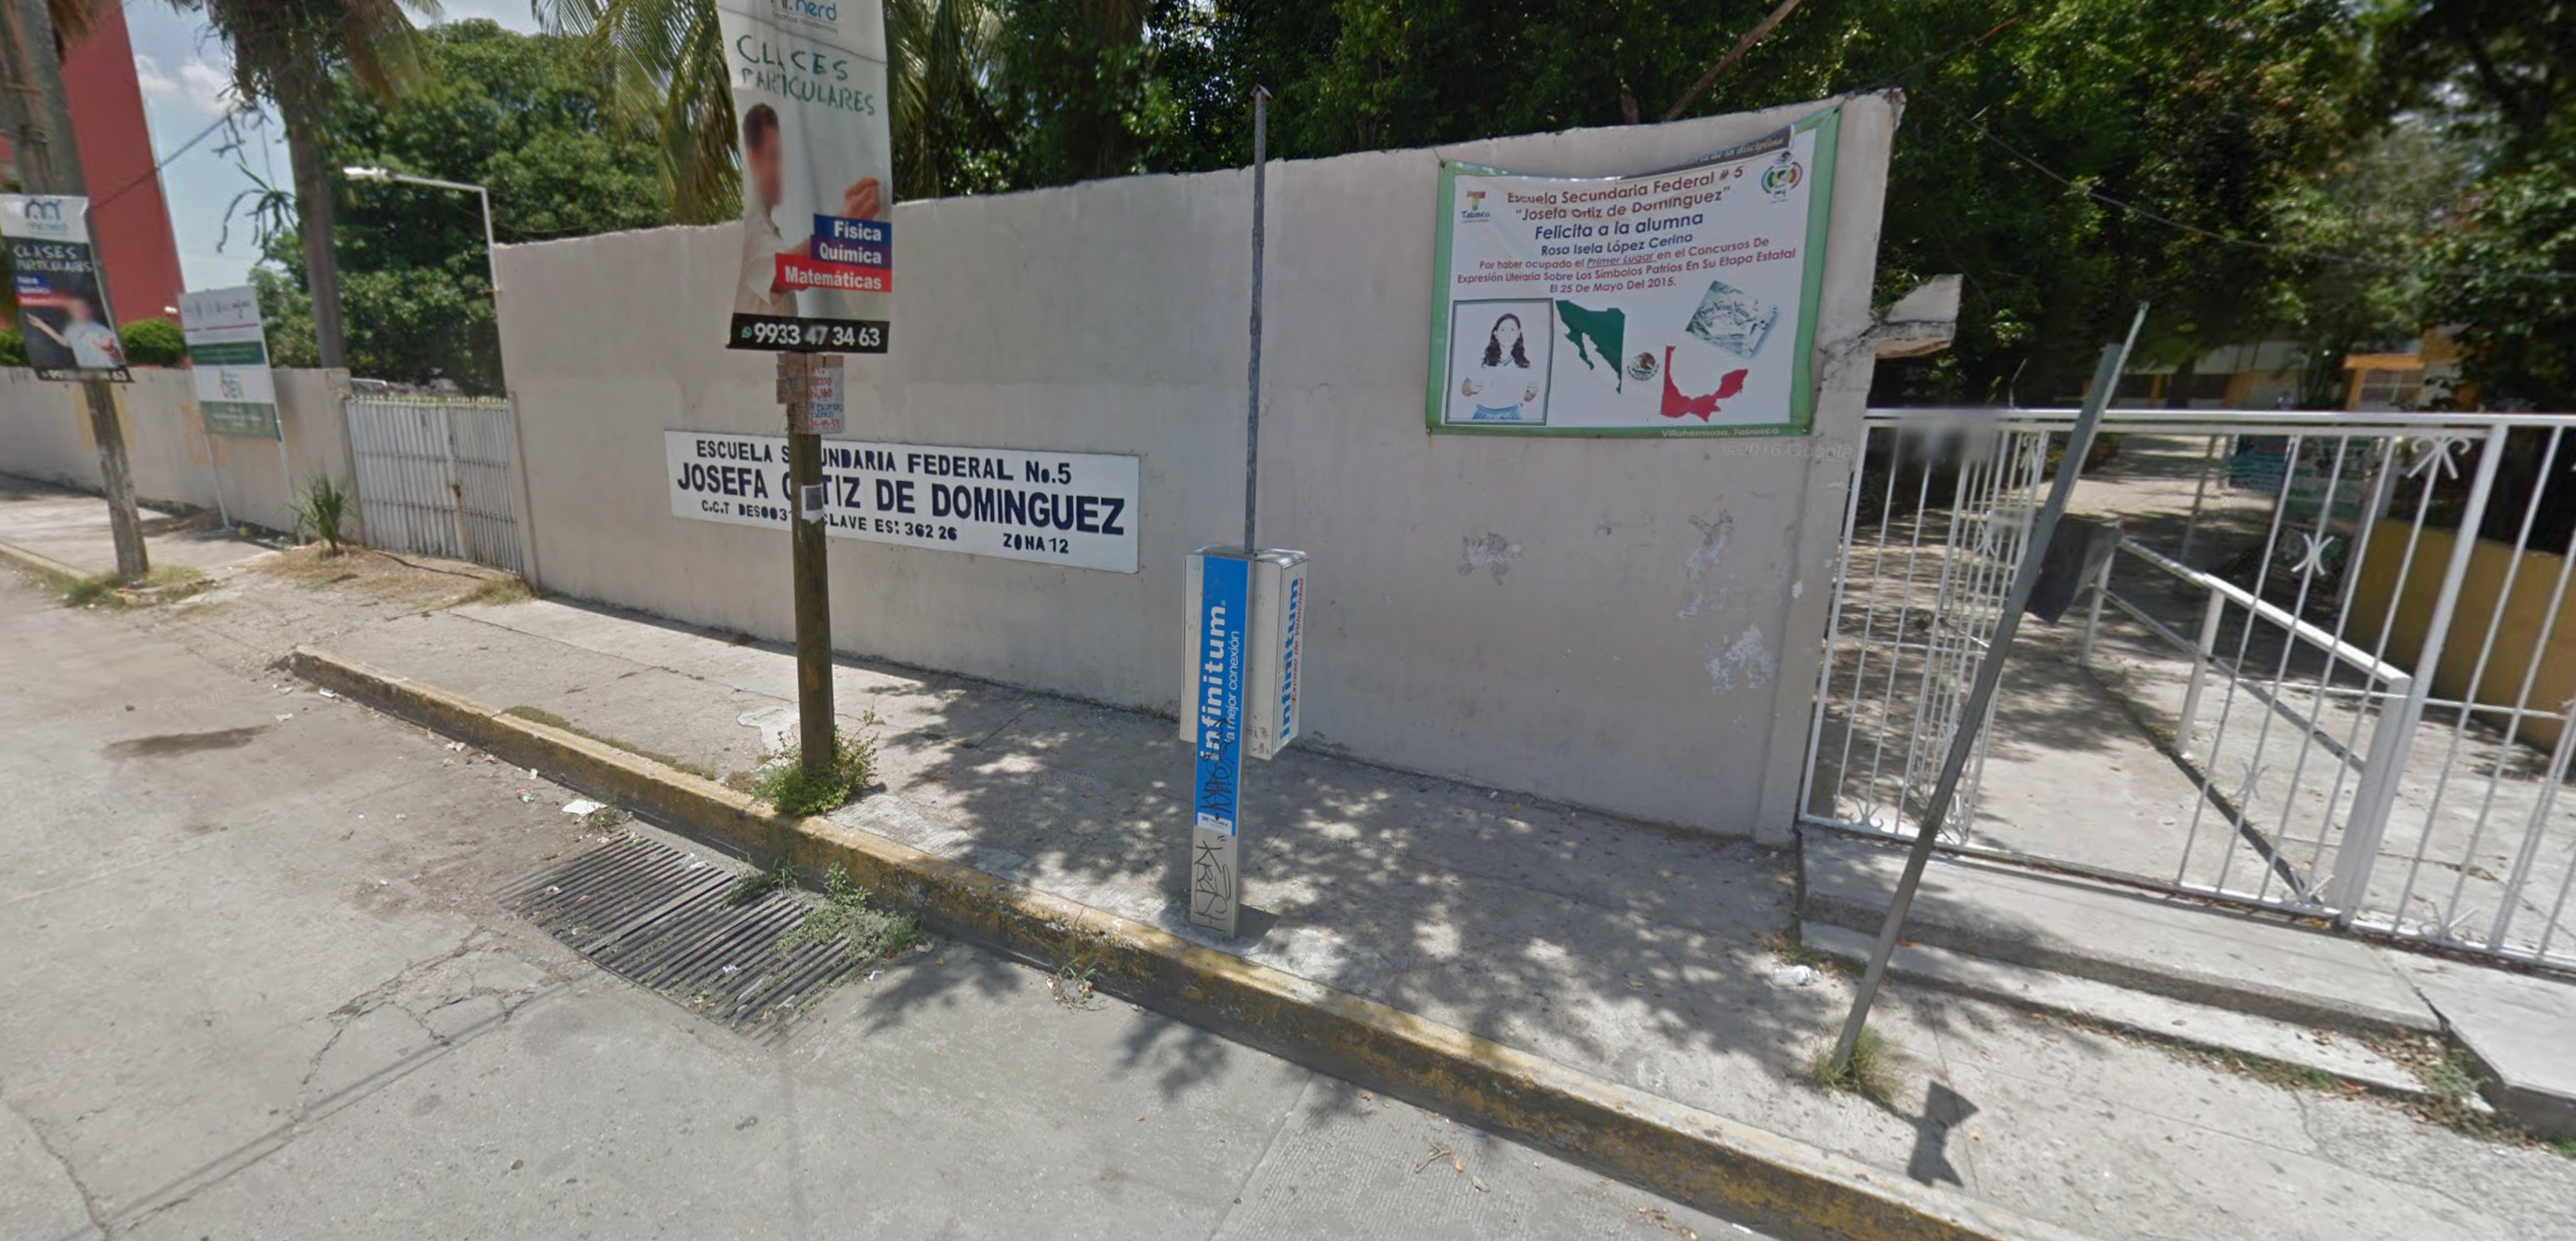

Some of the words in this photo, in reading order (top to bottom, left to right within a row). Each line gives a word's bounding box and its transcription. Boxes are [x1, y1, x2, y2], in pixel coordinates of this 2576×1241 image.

[771, 0, 837, 21] .nerd
[1507, 192, 1557, 204] Escuela
[1561, 183, 1647, 204] Secundaria
[1653, 171, 1714, 193] Federal
[1719, 169, 1729, 180] #
[1734, 166, 1744, 178] 5
[1534, 224, 1593, 240] Felicita
[1598, 224, 1609, 236] a
[1614, 221, 1629, 234] la
[1635, 213, 1704, 234] alumna
[1571, 207, 1602, 219] Ortiz
[1607, 205, 1627, 217] de
[833, 220, 882, 241] Física
[1541, 246, 1570, 256] Rosa
[1573, 244, 1602, 254] Isela
[1607, 240, 1644, 255] López
[1649, 233, 1693, 248] Cerino
[819, 243, 882, 264] Química
[1457, 273, 1503, 285] Expresión
[1544, 272, 1573, 281] Sobre
[1576, 271, 1592, 280] Los
[1646, 263, 1682, 274] Patrios
[1686, 260, 1699, 271] En
[1703, 259, 1716, 270] Su
[1720, 255, 1753, 266] Etapa
[1756, 248, 1797, 261] Estatal
[1480, 260, 1494, 270] Por
[1497, 260, 1522, 269] haber
[1525, 259, 1572, 270] ocupado
[1574, 259, 1584, 267] el
[1587, 257, 1620, 266] Primer
[1623, 253, 1654, 264] Lugar
[1656, 251, 1671, 260] en
[1675, 248, 1685, 259] el
[1688, 241, 1750, 257] Concursos
[1753, 237, 1770, 247] De
[785, 266, 882, 289] Matemáticas
[1549, 284, 1558, 293] El
[1560, 284, 1573, 293] 25
[1576, 284, 1589, 292] De
[1592, 283, 1623, 293] Mayo
[1627, 280, 1644, 289] Del
[1647, 276, 1677, 287] 2015.
[754, 323, 801, 345] 9933
[804, 326, 830, 344] 47
[832, 327, 855, 346] 34
[857, 327, 881, 346] 63
[697, 440, 773, 463] ESCUELA
[781, 446, 896, 472] SUNDARIA
[908, 453, 1014, 481] FEDERAL
[1026, 460, 1071, 485] No.5
[677, 462, 768, 499] JOSEFA
[782, 472, 860, 509] OTIZ
[876, 478, 916, 514] DE
[932, 483, 1125, 536] DOMINGUEZ
[701, 500, 730, 514] C.C.T
[1003, 533, 1045, 552] ZONA
[1048, 538, 1069, 554] 12
[1227, 631, 1240, 691] conexión
[1281, 579, 1298, 740] infinitum
[1225, 696, 1239, 729] mejor
